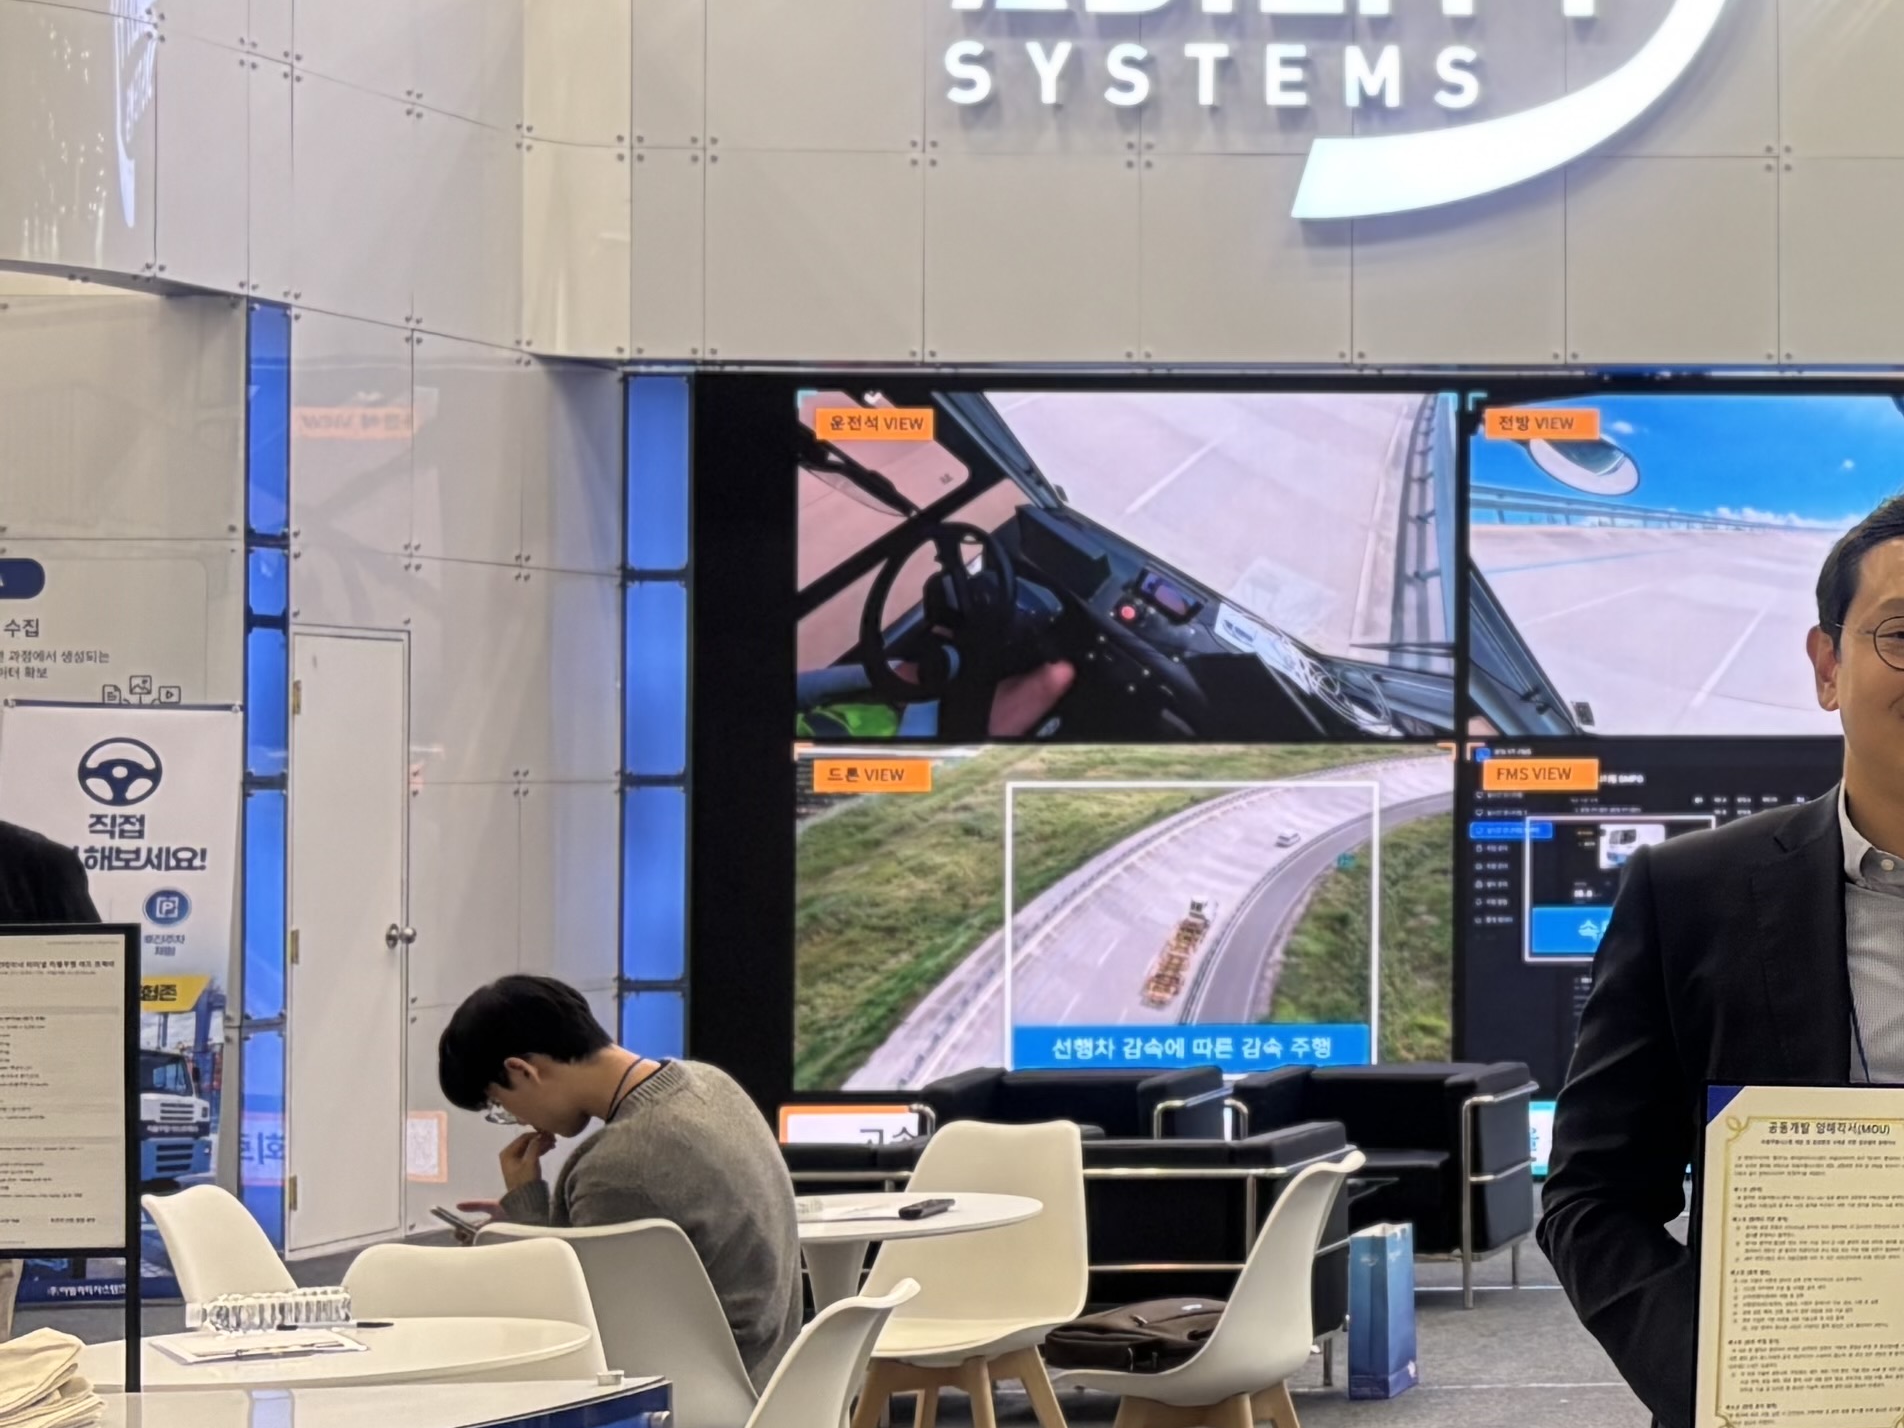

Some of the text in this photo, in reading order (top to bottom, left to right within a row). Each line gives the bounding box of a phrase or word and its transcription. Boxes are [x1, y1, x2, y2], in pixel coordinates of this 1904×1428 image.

[944, 39, 1482, 110] SYSTEMS
[830, 415, 924, 431] 운전석 VIEW
[1500, 416, 1574, 431] 전방 VIEW
[4, 618, 39, 638] 수집
[8, 650, 110, 663] 과정에서 생성되는
[864, 768, 905, 781] VIEW
[1496, 767, 1572, 781] FMS VIEW
[88, 814, 146, 839] 직접
[73, 845, 207, 871] 해보세요!
[140, 984, 177, 1002] 험존
[1053, 1037, 1331, 1060] 선행차 감속에 따른 감속 주행
